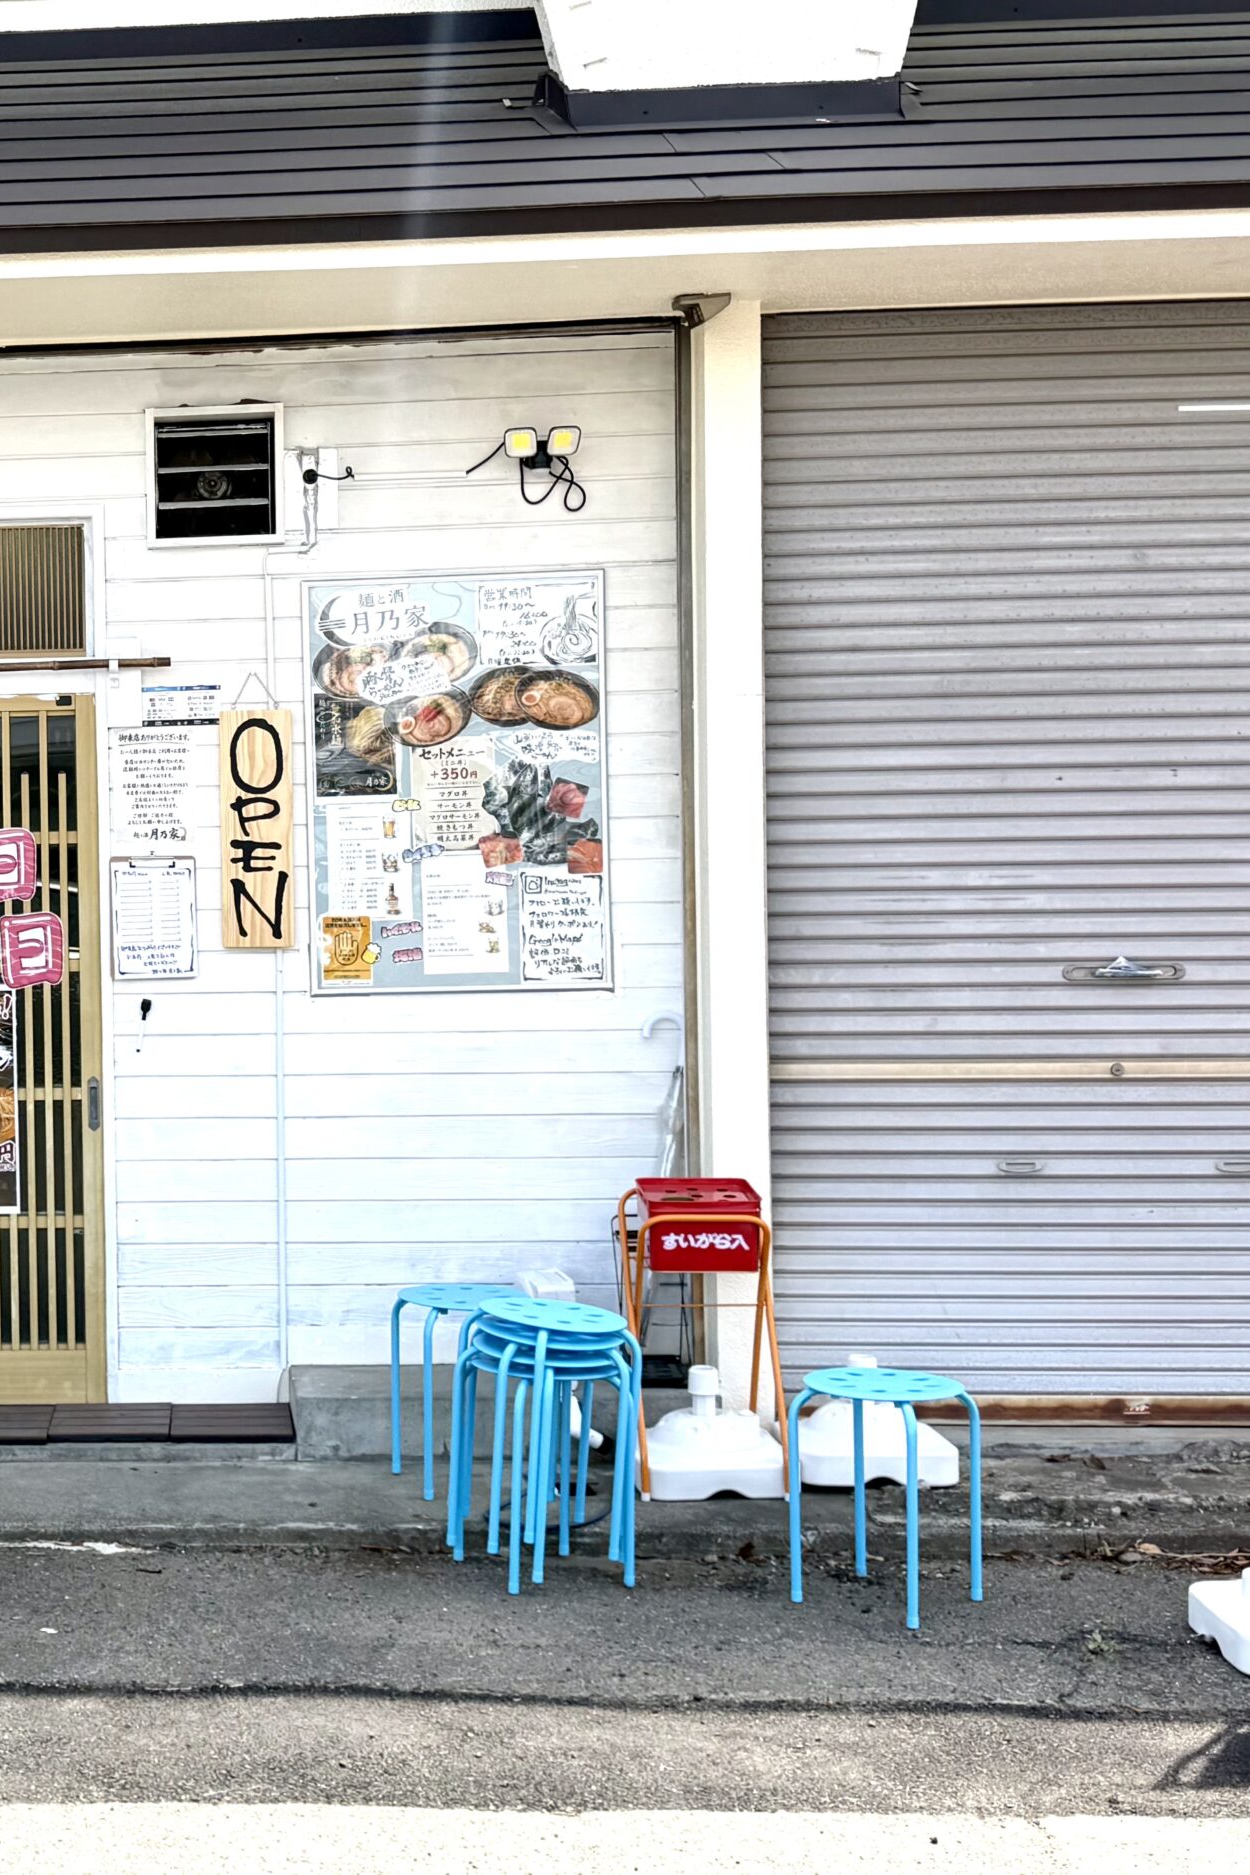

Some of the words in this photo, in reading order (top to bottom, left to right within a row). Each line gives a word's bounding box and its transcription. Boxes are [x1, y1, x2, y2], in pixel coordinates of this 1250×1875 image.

[358, 588, 405, 608] 麺と酒
[351, 605, 429, 635] 月乃家
[419, 747, 486, 762] セットメニュー
[438, 789, 469, 798] マグロ丼
[437, 801, 472, 809] サーモン丼
[429, 812, 480, 821] マグロサーモン丼
[229, 717, 289, 942] OPEN
[661, 1232, 750, 1251] すいがら入
